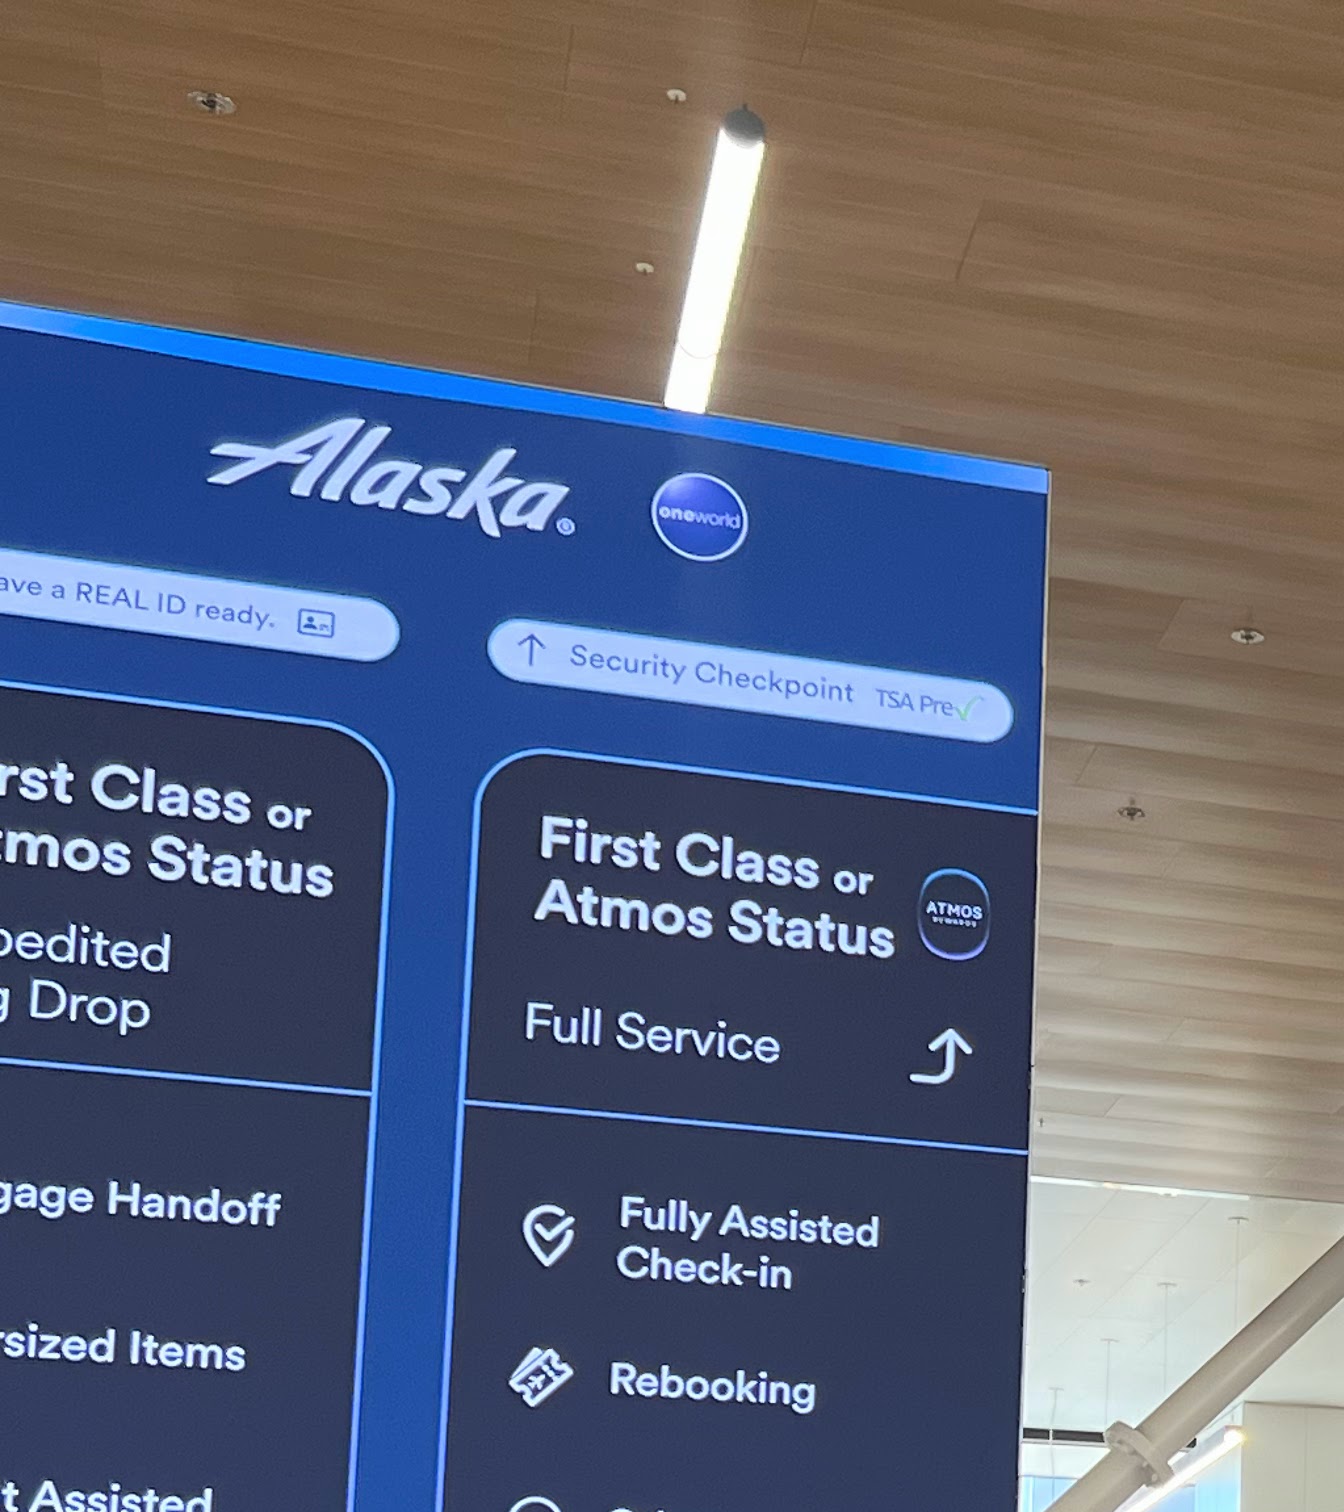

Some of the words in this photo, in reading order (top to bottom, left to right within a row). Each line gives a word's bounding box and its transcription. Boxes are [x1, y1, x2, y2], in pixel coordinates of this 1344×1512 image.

[658, 504, 741, 530] oneworld
[51, 581, 66, 599] a
[76, 582, 149, 611] REAL
[158, 592, 186, 616] ID
[195, 602, 275, 632] ready.
[569, 644, 687, 685] Security
[695, 660, 854, 705] Checkpoint
[876, 688, 914, 712] TSA
[91, 763, 252, 825] Class
[267, 804, 312, 831] or
[0, 829, 132, 876] mos
[147, 834, 335, 898] Status
[540, 814, 661, 871] First
[676, 831, 820, 889] Class
[833, 866, 874, 896] or
[533, 878, 713, 940] Atmos
[728, 899, 895, 959] Status
[926, 900, 983, 920] ATMOS
[30, 977, 151, 1036] Drop
[525, 1002, 601, 1046] Full
[615, 1011, 781, 1064] Service
[107, 1180, 282, 1227] Handoff
[620, 1196, 712, 1241] Fully
[719, 1204, 880, 1248] Assisted
[616, 1245, 792, 1290] Check-in
[130, 1329, 247, 1371] Items
[610, 1361, 816, 1414] Rebooking
